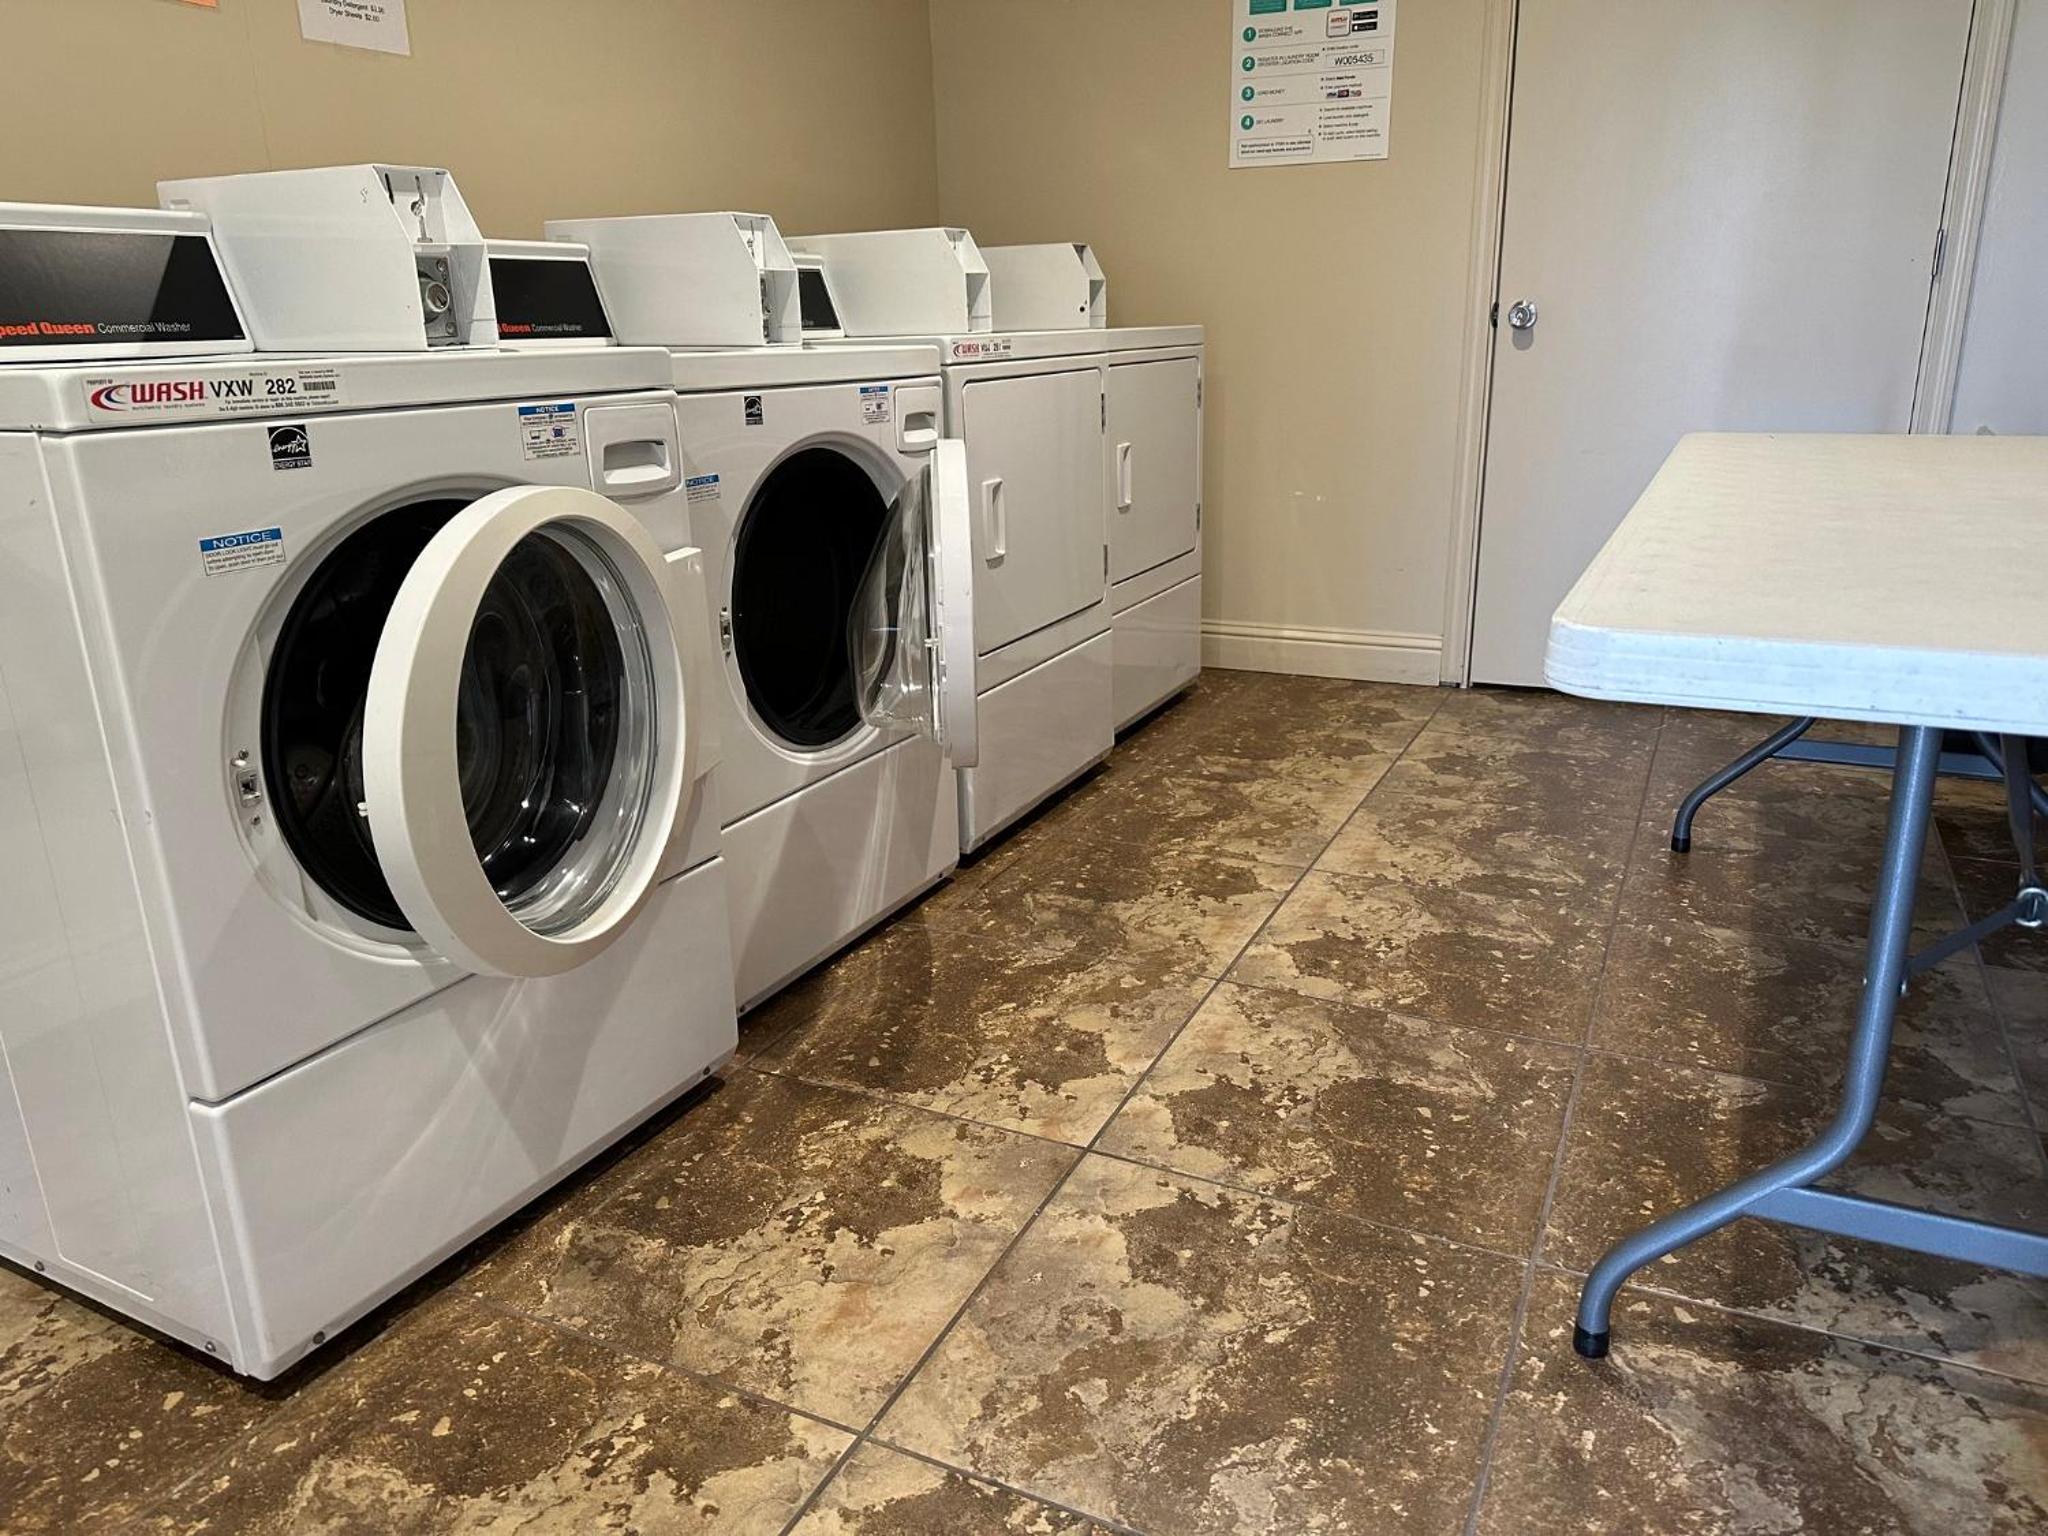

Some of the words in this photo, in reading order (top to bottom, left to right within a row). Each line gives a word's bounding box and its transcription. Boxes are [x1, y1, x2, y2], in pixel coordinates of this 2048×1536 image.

[0, 322, 40, 339] peed
[41, 321, 97, 335] Queen
[98, 322, 155, 335] Commercial
[156, 322, 191, 333] Washer
[502, 323, 532, 334] Queen
[131, 381, 206, 404] WASH
[209, 380, 254, 398] VXW
[265, 378, 298, 395] 282
[212, 532, 272, 548] NOTICE
